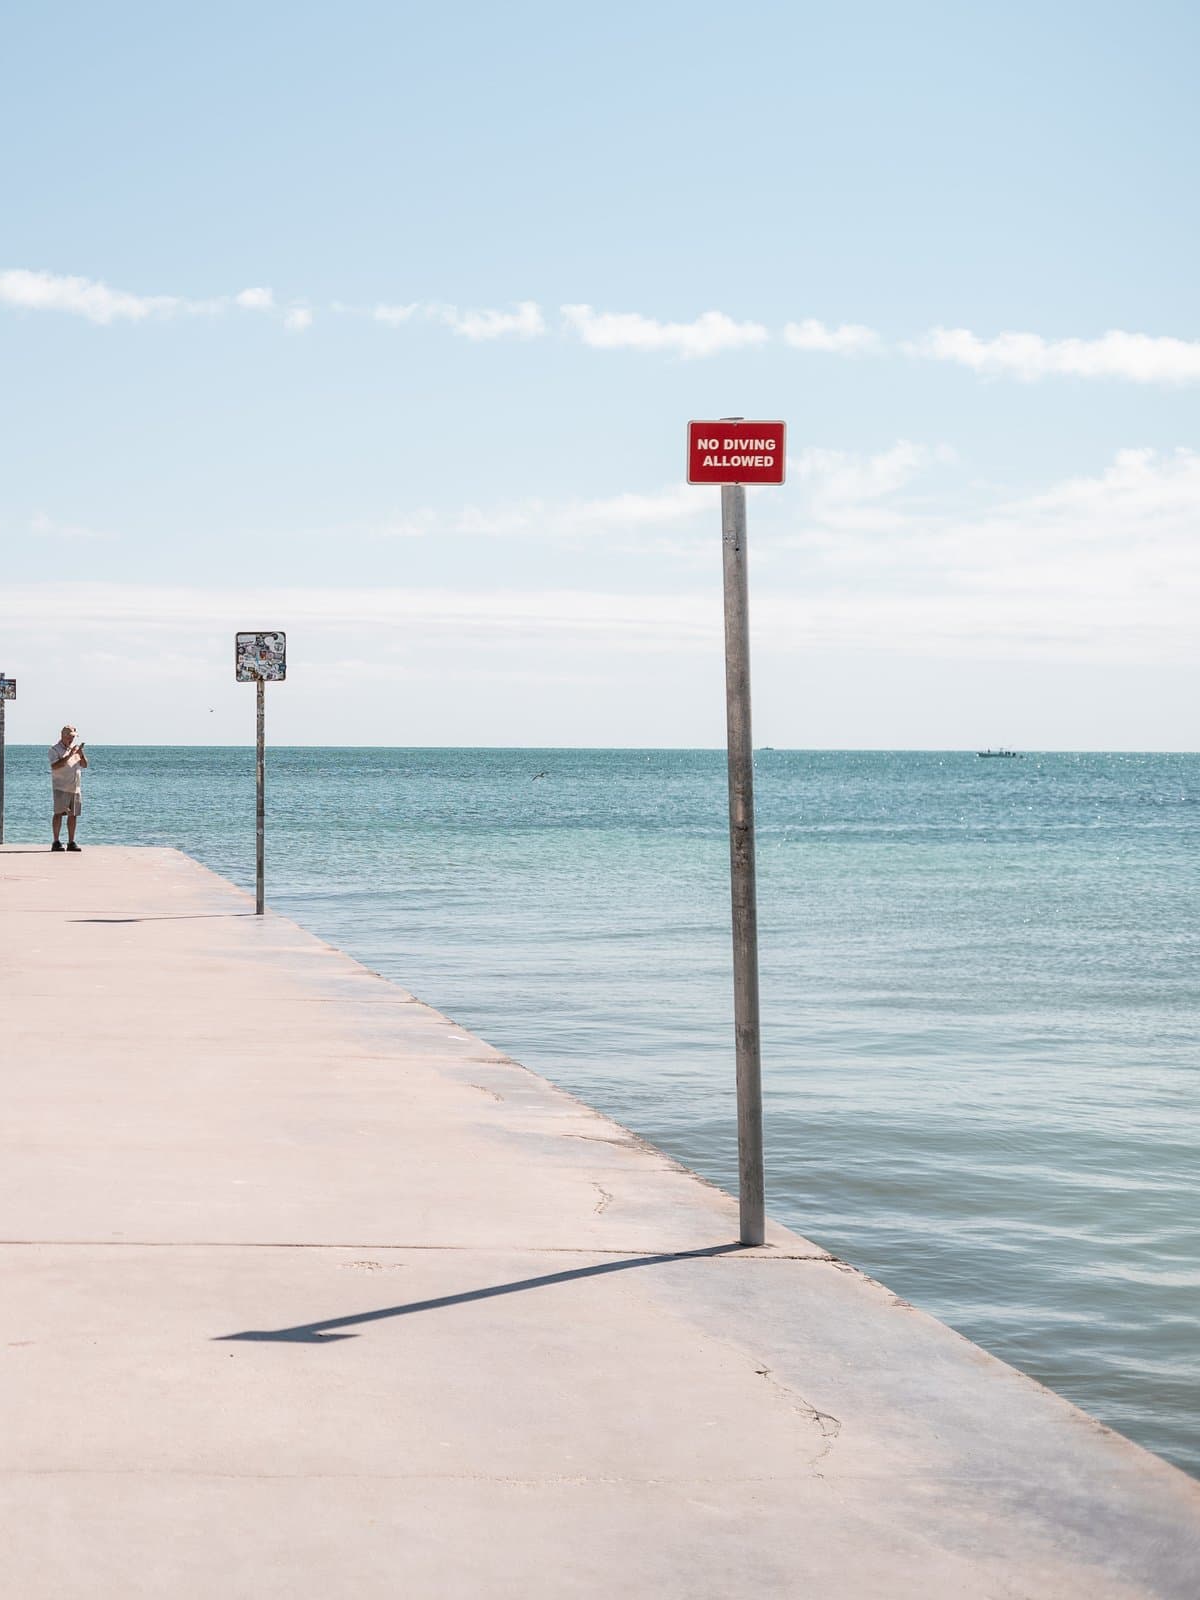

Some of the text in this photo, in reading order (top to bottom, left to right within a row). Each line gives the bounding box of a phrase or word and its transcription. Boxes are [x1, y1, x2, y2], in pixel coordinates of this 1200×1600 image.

[697, 438, 776, 450] NO DIVING
[702, 455, 774, 467] ALLOWED
